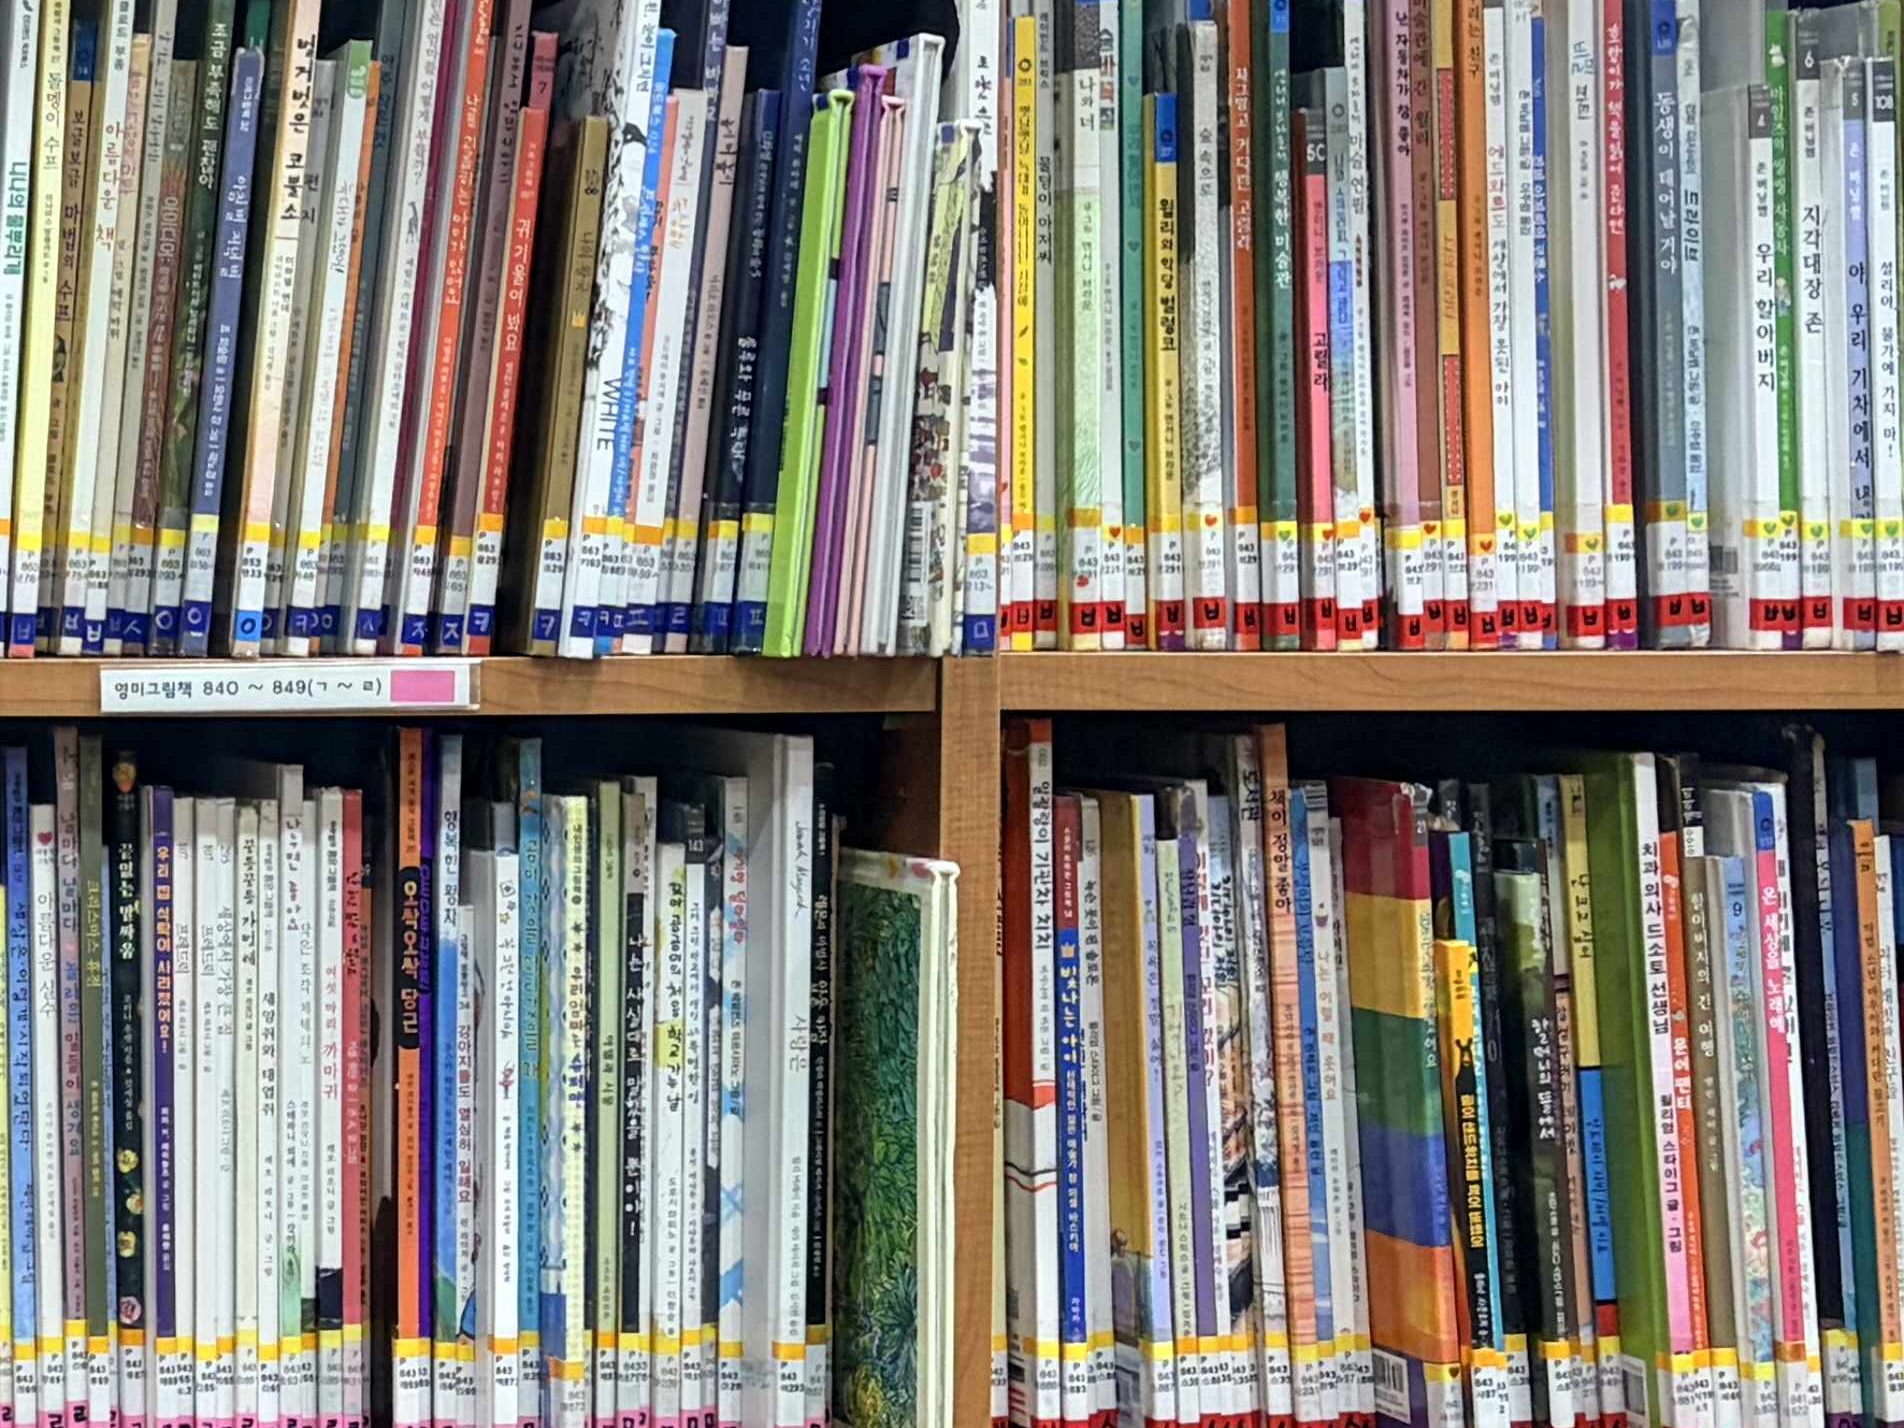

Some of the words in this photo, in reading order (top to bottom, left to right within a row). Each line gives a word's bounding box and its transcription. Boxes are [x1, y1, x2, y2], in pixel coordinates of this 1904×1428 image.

[1804, 51, 1814, 67] 6
[1655, 93, 1675, 160] 동생이
[100, 122, 121, 211] 아름다운
[95, 226, 115, 251] 책
[515, 219, 532, 238] 귀
[1159, 198, 1175, 253] 윌리와
[1659, 238, 1676, 274] 거야
[1802, 205, 1822, 300] 지각대장
[1159, 256, 1175, 291] 악당
[1804, 312, 1823, 335] 존
[114, 678, 192, 698] 영미그림책
[202, 678, 239, 695] 840
[1270, 787, 1288, 829] 책이
[1271, 834, 1290, 875] 정말
[1642, 841, 1660, 876] 치과
[1274, 876, 1291, 915] 좋아
[1643, 881, 1662, 916] 의사
[36, 892, 55, 975] 아름다운
[400, 880, 418, 981] 오싹오싹
[1645, 924, 1666, 976] 드소토
[38, 979, 57, 1018] 실수
[401, 988, 419, 1035] 당근
[1650, 981, 1669, 1036] 선생님
